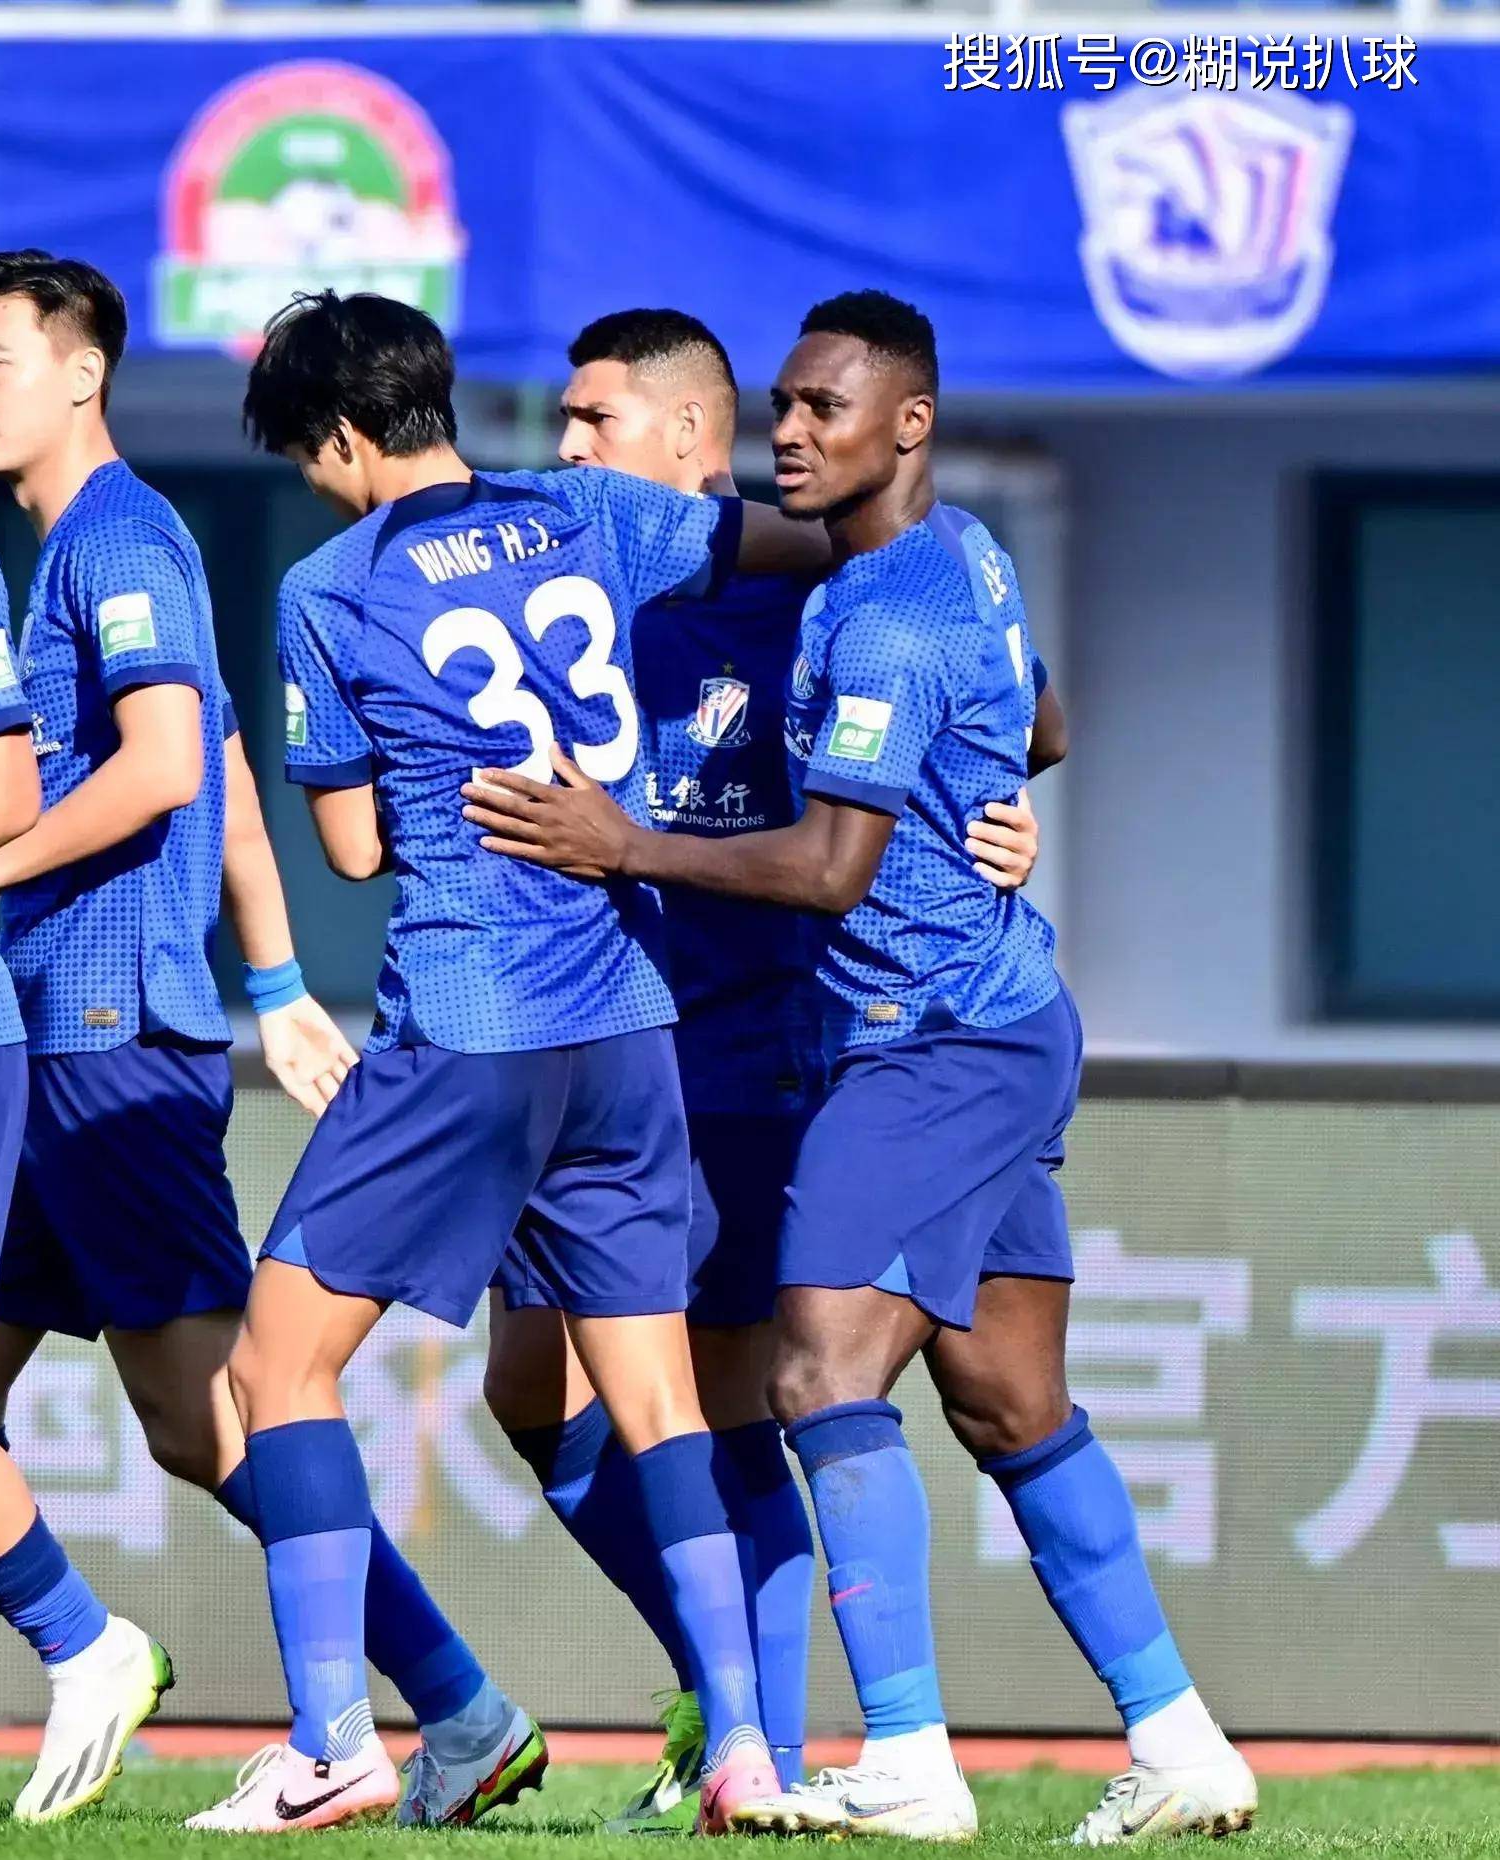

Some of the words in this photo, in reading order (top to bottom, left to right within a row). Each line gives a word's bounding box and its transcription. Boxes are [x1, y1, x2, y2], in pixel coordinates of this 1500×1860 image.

[406, 528, 492, 585] WANG
[496, 517, 560, 563] H.J.
[422, 575, 638, 797] 33
